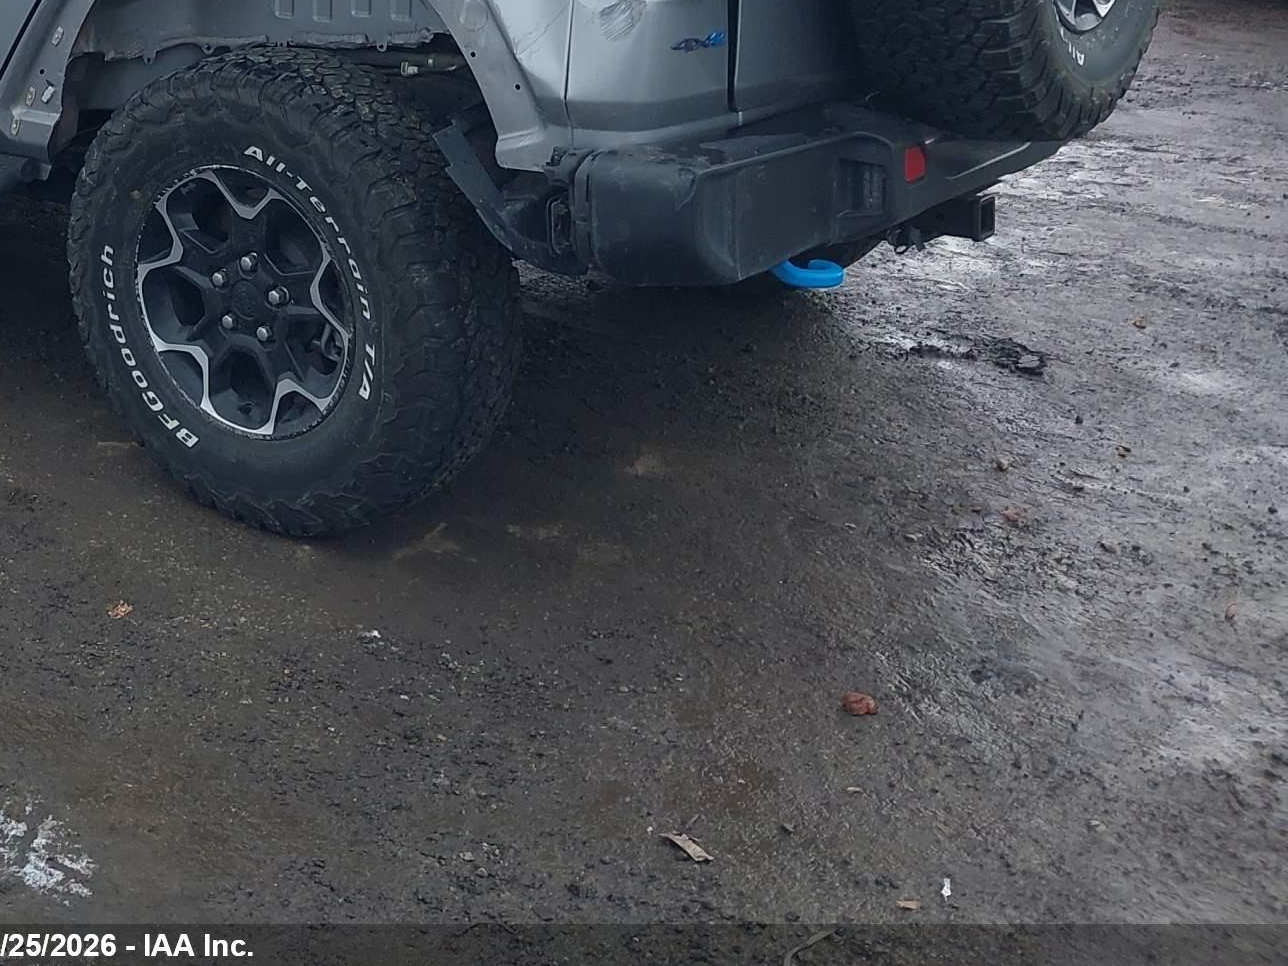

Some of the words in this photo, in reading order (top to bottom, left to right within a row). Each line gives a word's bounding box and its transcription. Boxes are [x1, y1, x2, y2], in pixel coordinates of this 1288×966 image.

[100, 245, 200, 448] BFGoodrich
[243, 145, 371, 320] All-Terrain
[359, 343, 376, 401] T/A
